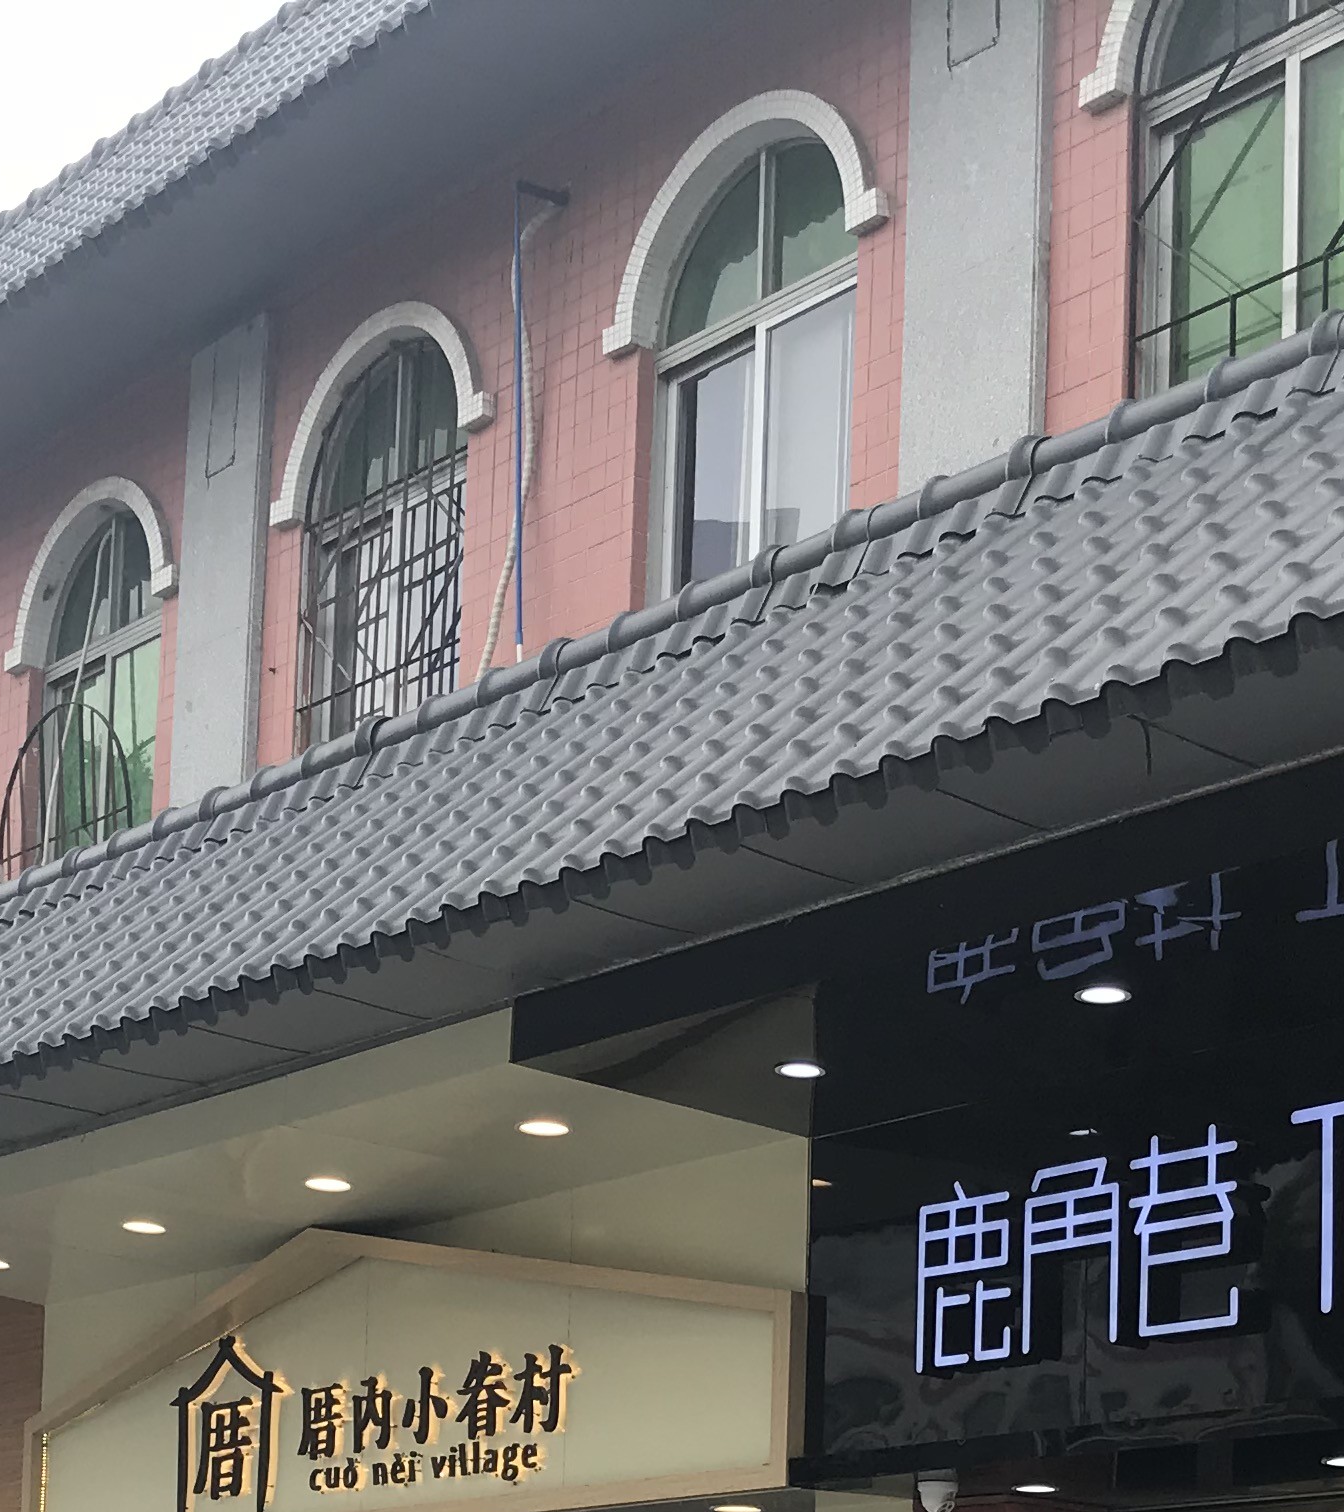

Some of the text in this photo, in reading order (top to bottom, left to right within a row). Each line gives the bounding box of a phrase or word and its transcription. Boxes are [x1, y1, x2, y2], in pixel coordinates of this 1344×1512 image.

[915, 1124, 1240, 1374] 鹿角巷
[431, 1441, 538, 1482] village
